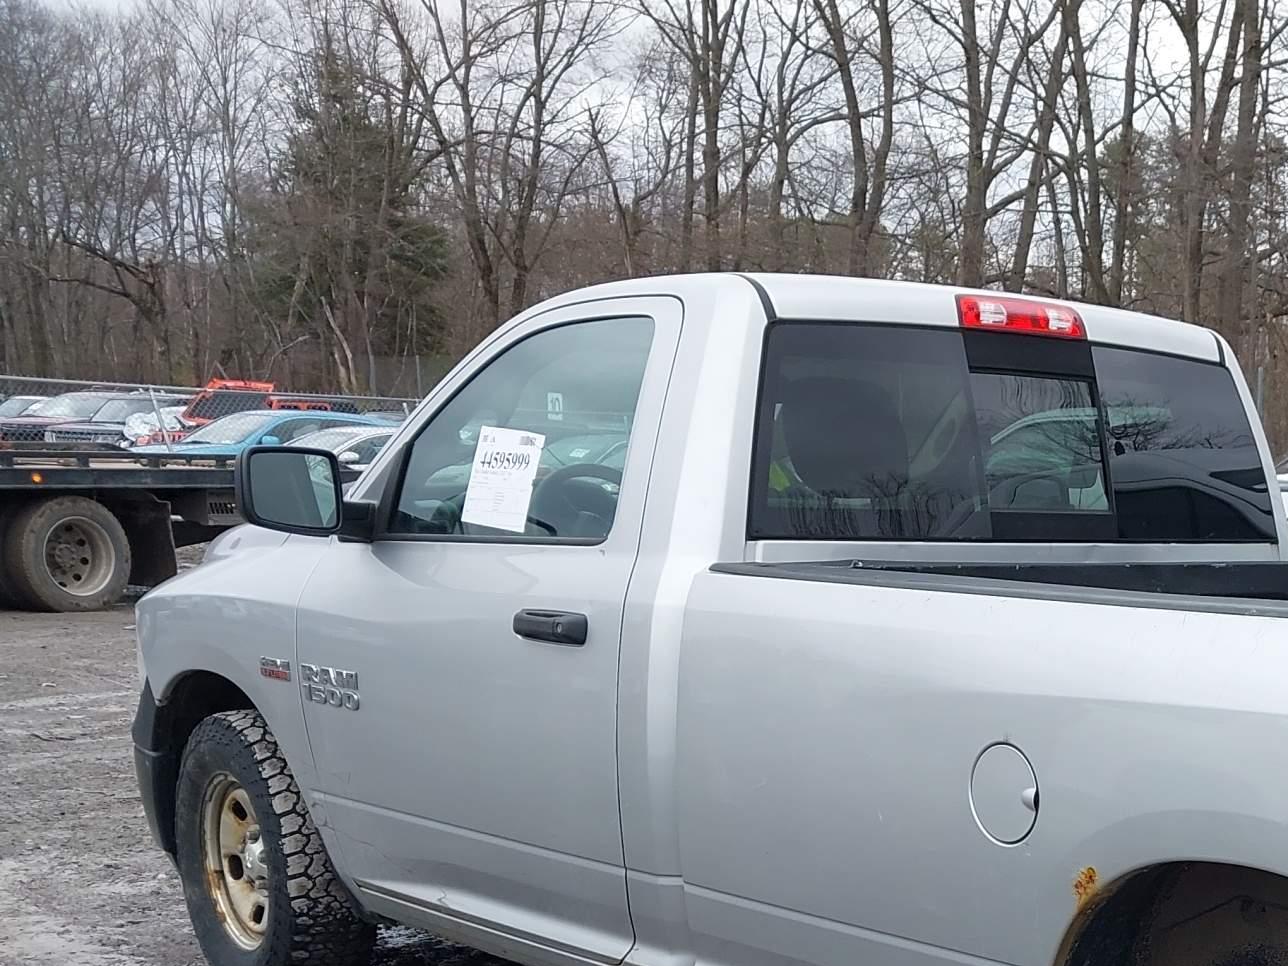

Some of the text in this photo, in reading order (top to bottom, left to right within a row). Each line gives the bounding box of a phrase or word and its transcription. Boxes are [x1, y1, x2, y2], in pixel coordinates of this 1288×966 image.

[480, 451, 531, 470] 44595999
[301, 662, 359, 690] RAM
[302, 683, 360, 711] 1500
